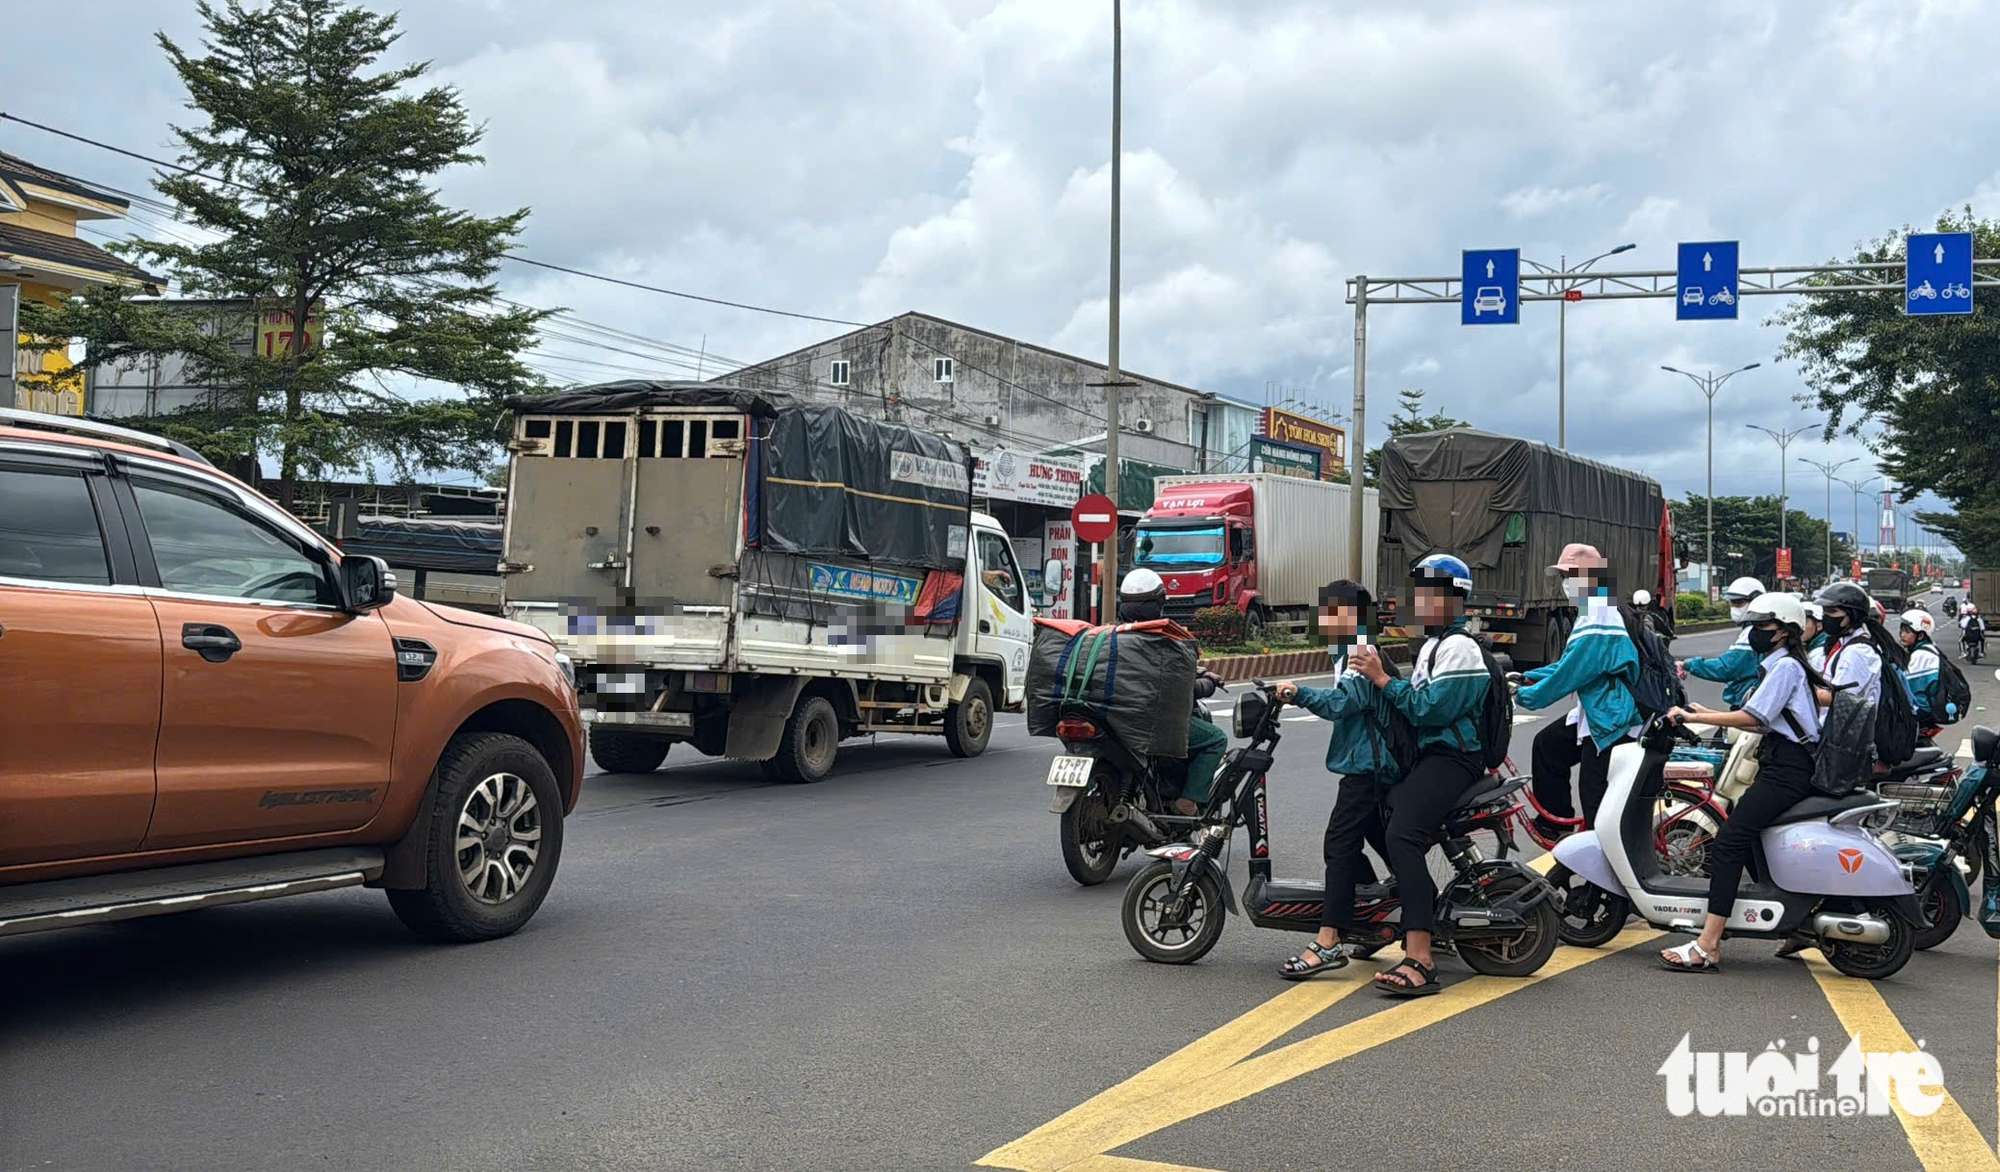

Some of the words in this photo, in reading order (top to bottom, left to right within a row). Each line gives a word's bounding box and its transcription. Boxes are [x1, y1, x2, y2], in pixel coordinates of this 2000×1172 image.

[1288, 421, 1302, 440] TÔN
[1302, 428, 1317, 443] HOA
[1317, 432, 1330, 447] SEN
[1029, 463, 1053, 481] HƯNG
[1055, 467, 1081, 487] THỊNH
[1162, 499, 1185, 510] VẠN
[1187, 499, 1205, 509] LỢI
[1049, 524, 1071, 540] PHÂN
[1051, 545, 1068, 560] BÓN
[1257, 796, 1266, 836] YUKATA
[1653, 904, 1679, 913] YADEA
